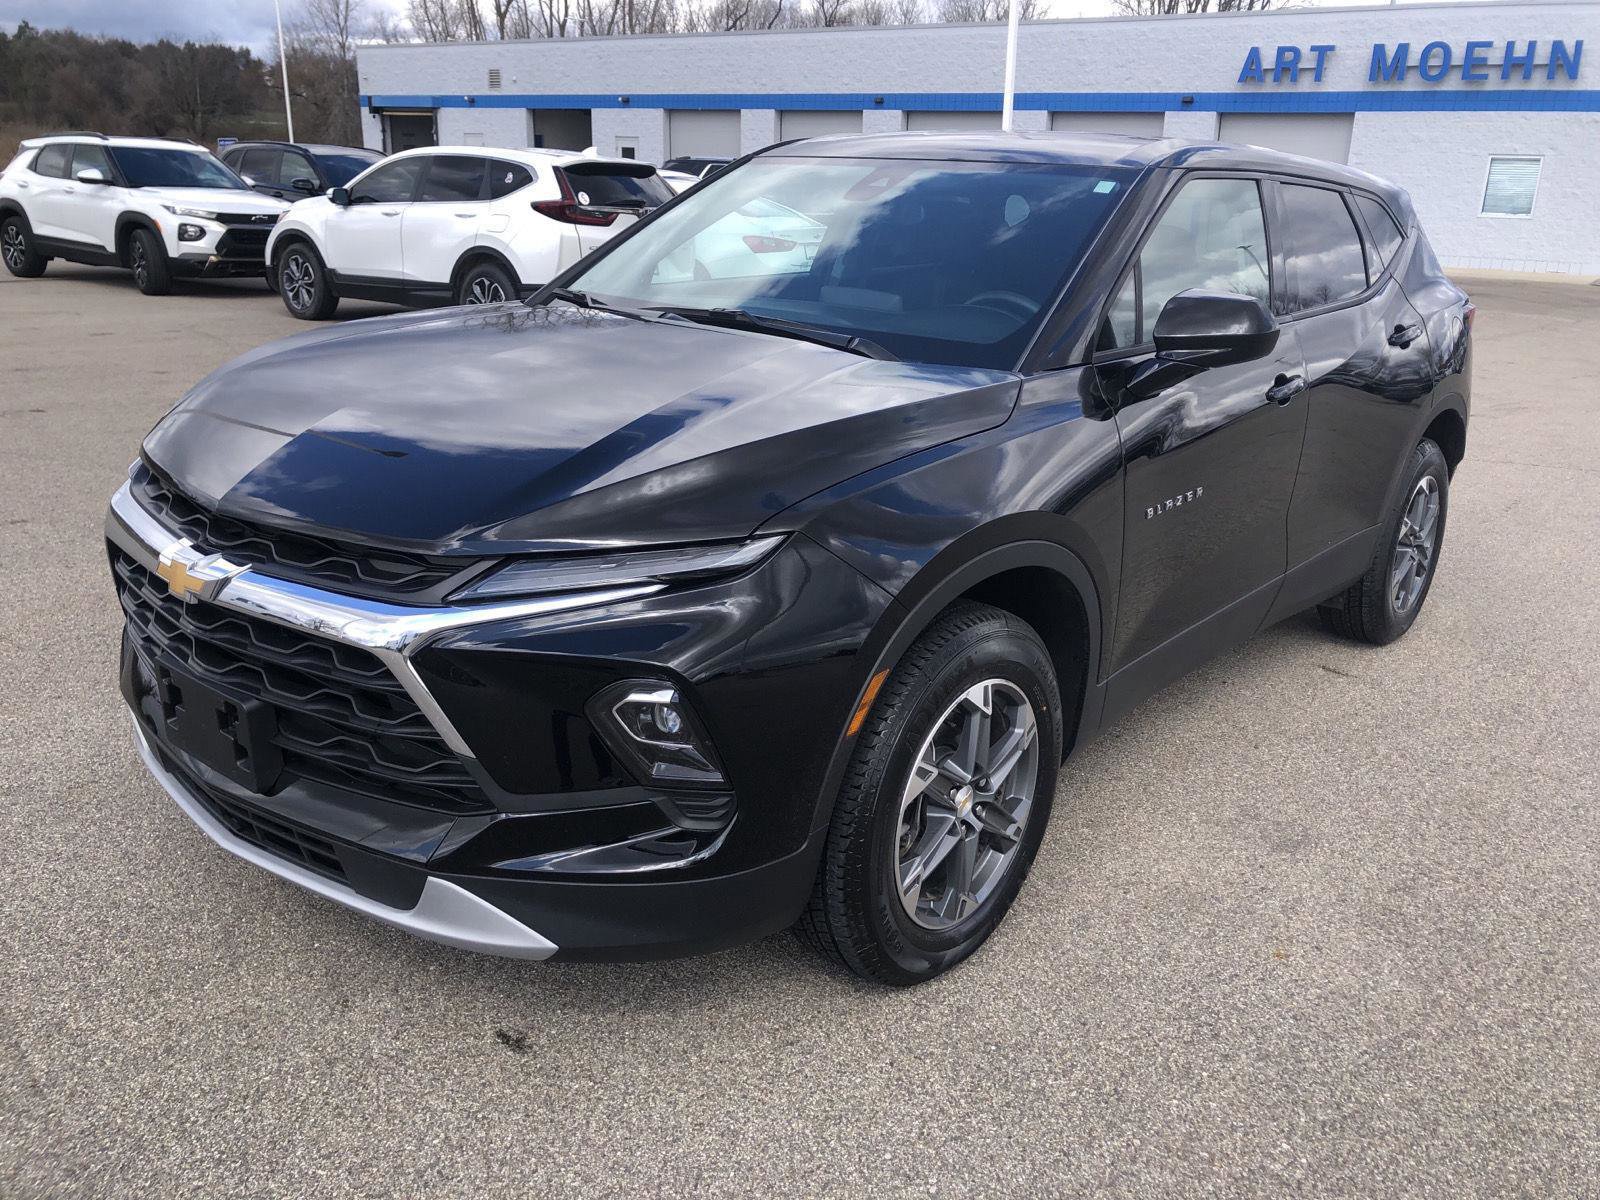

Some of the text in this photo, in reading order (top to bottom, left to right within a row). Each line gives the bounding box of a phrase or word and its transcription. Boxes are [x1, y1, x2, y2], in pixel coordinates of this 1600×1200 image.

[1238, 39, 1584, 83] ART MOEHN
[1145, 486, 1204, 519] BLAZER
